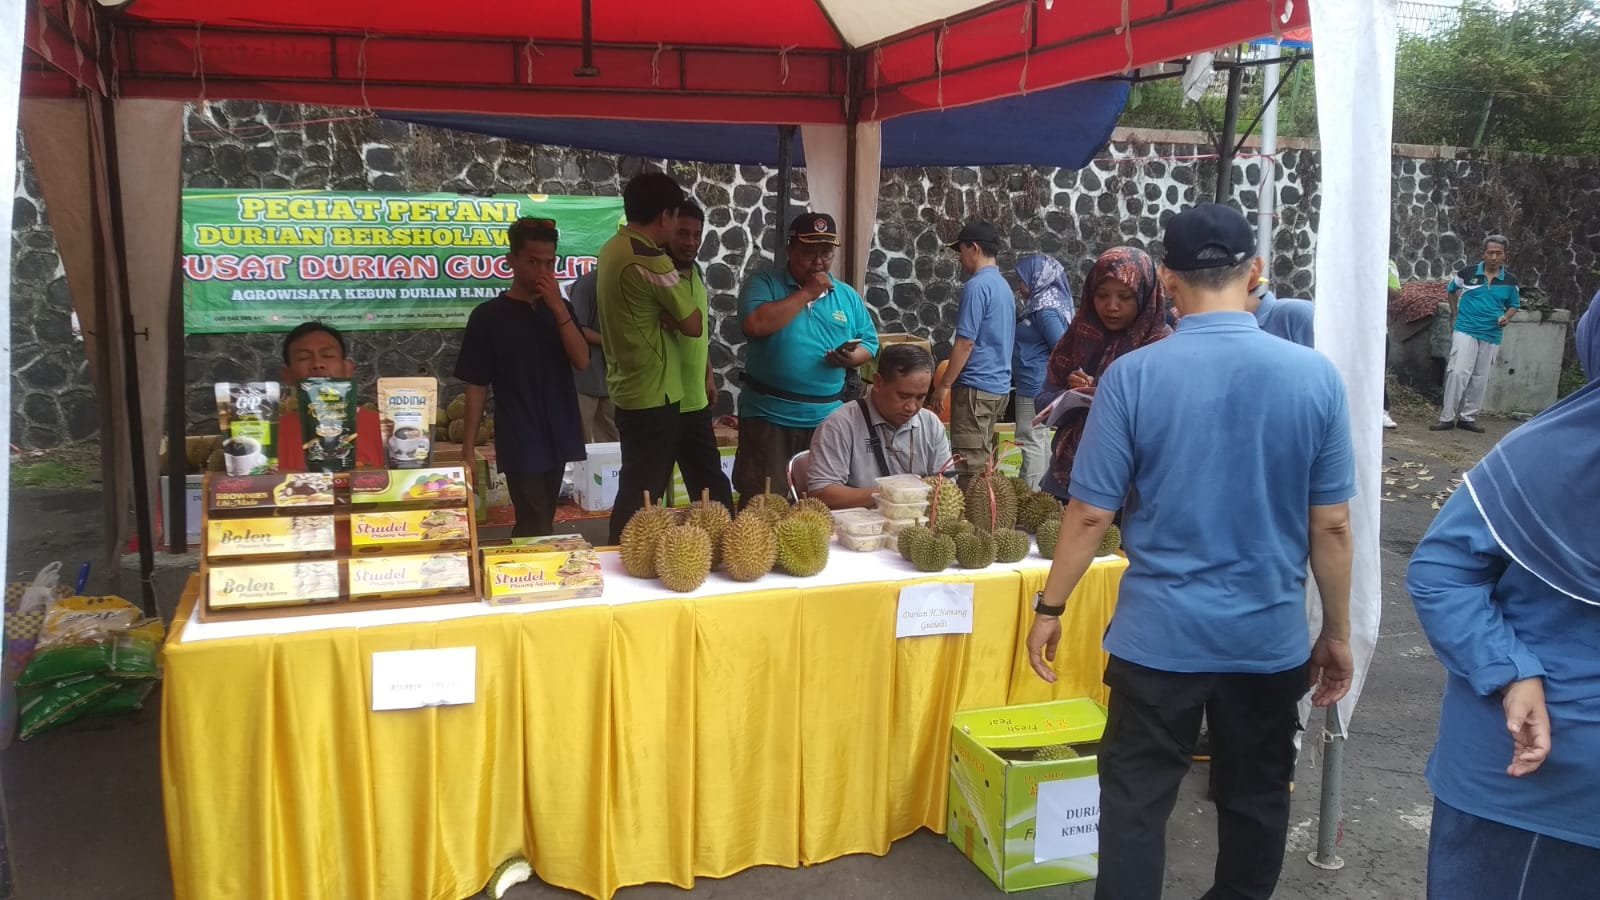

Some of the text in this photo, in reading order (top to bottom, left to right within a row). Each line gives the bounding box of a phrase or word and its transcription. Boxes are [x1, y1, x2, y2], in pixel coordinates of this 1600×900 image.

[240, 197, 519, 222] PEGIAT PETANI
[196, 225, 511, 247] DURIAN BERSHOLAW
[183, 255, 291, 279] USAT
[299, 255, 438, 279] DURIAN
[232, 288, 341, 300] AGROWISATA
[345, 288, 396, 299] KEBUN
[400, 287, 457, 299] DURIAN
[215, 492, 269, 500] BROWNIES
[355, 521, 407, 534] Strudel
[221, 529, 272, 544] Bolen
[354, 567, 406, 581] Strudel
[495, 570, 544, 585] Strudel
[223, 577, 275, 594] Bolen
[1066, 806, 1099, 820] DURIA
[1061, 823, 1098, 837] KEMBA
